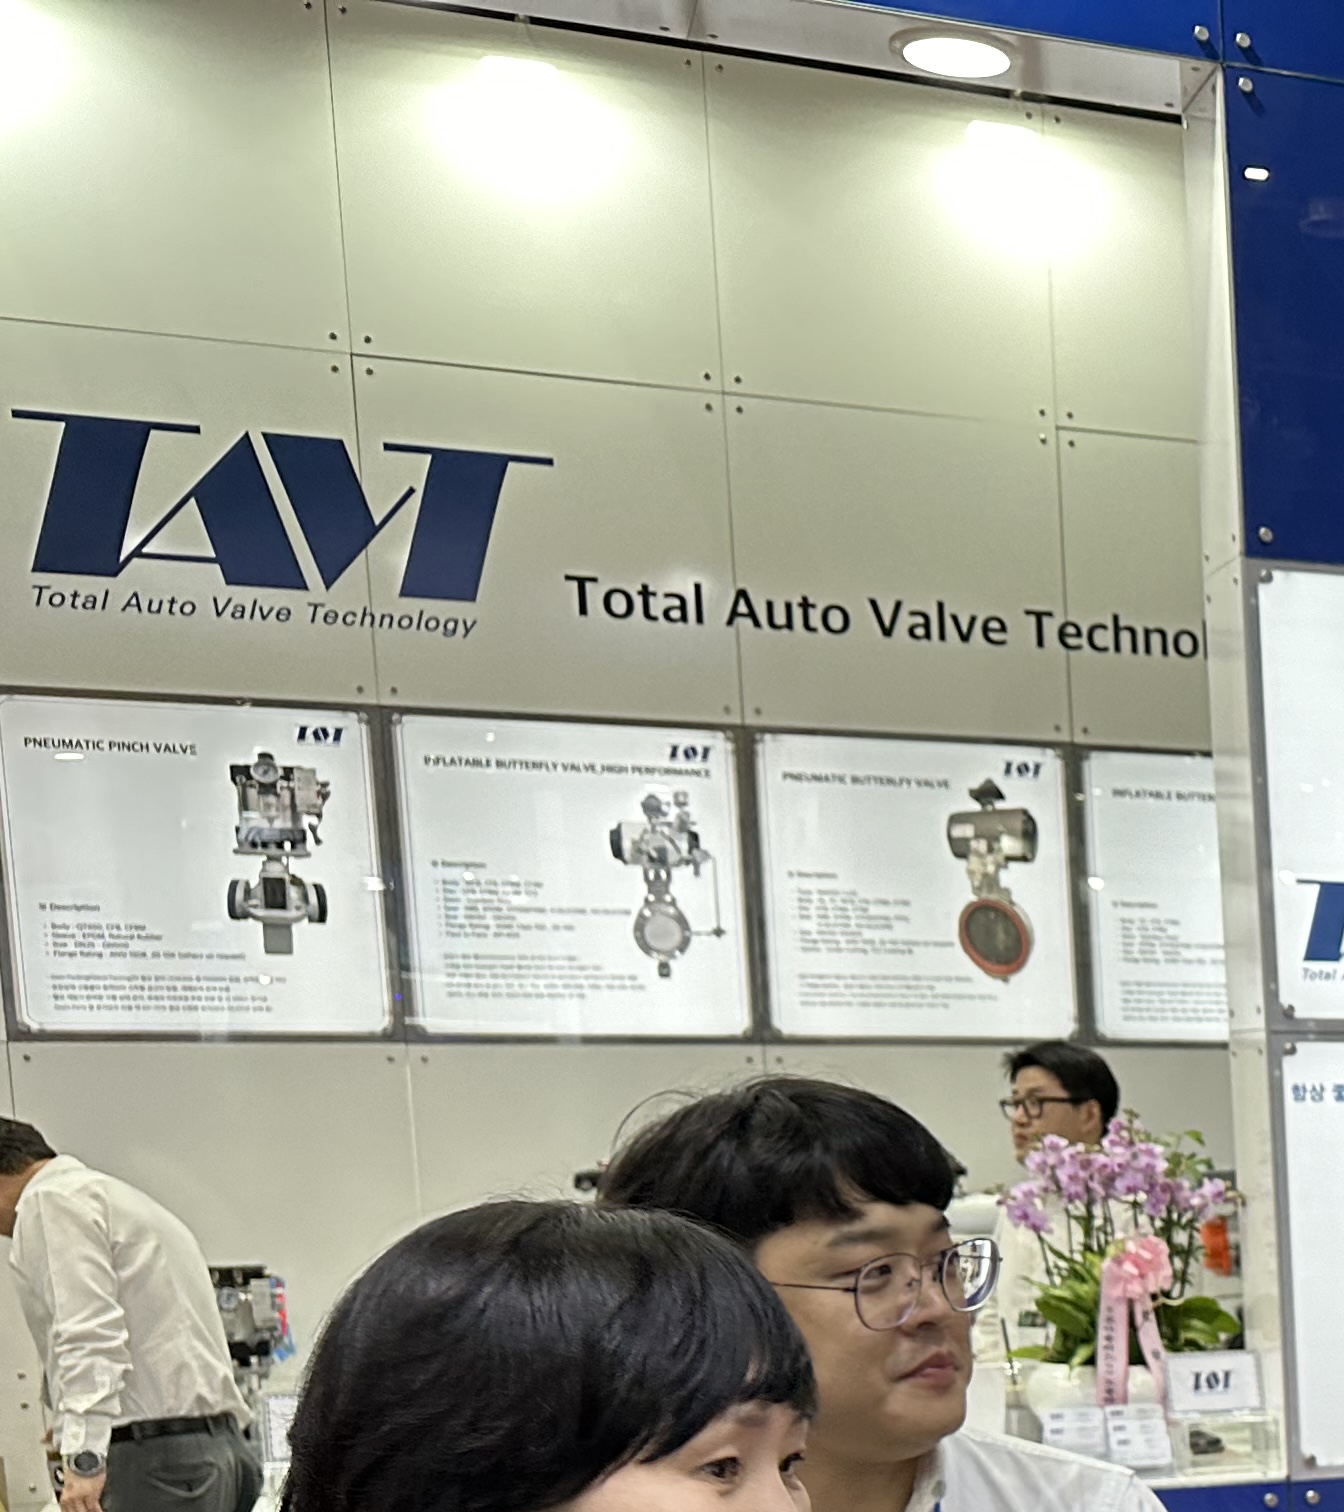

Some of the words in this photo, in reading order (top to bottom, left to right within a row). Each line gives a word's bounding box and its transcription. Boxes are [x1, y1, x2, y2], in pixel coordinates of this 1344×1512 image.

[11, 409, 554, 602] TAVT
[31, 585, 108, 612] Total
[122, 592, 196, 618] Auto
[213, 597, 291, 623] Valve
[307, 602, 477, 638] Technology
[564, 574, 703, 625] Total
[726, 589, 850, 635] Auto
[869, 598, 1008, 645] Valve
[23, 737, 104, 751] PNEUMATIC
[108, 739, 149, 753] PINCH
[153, 742, 197, 756] VALVE
[1302, 967, 1337, 981] Total
